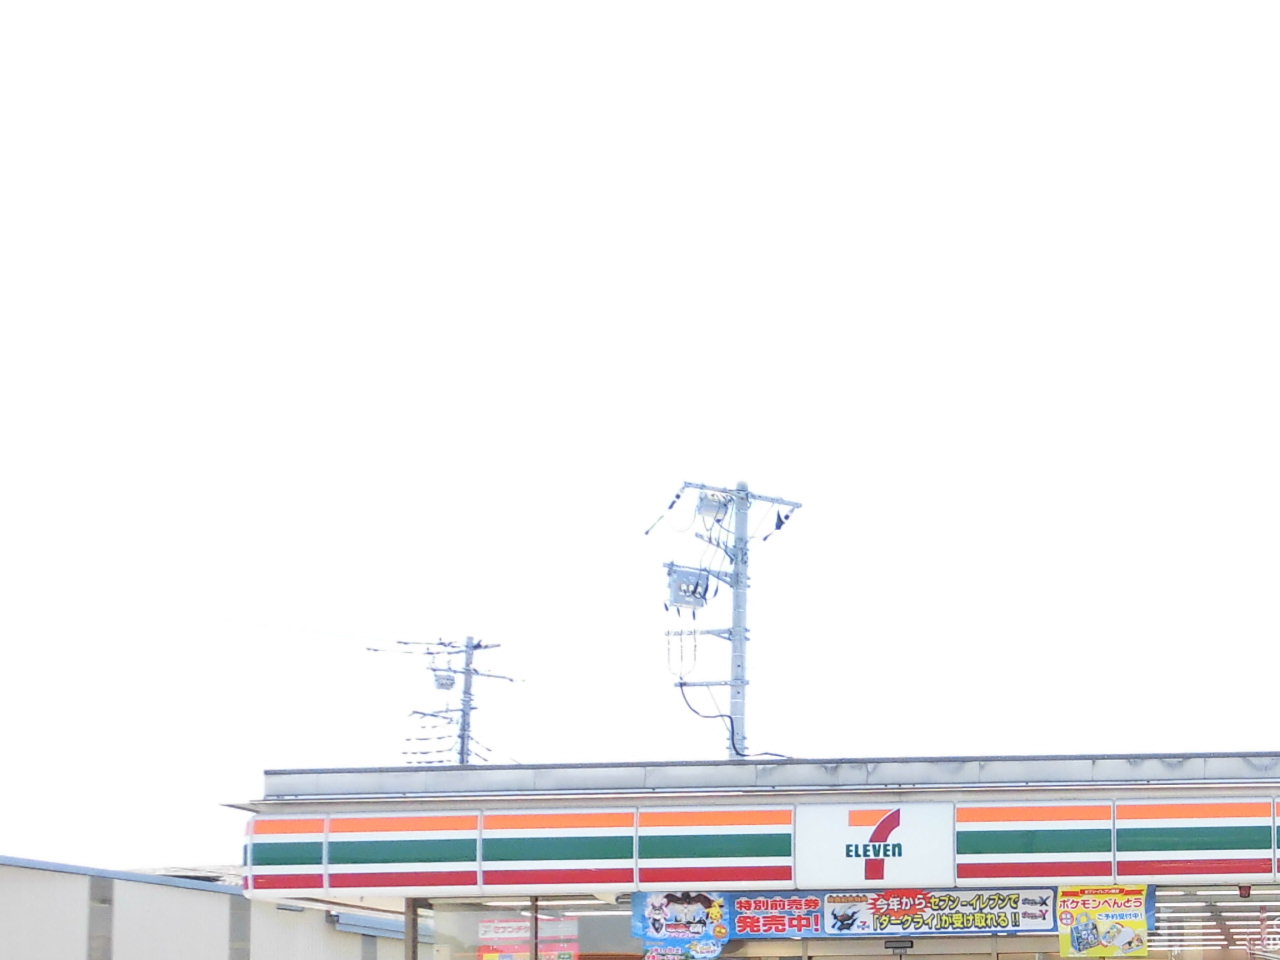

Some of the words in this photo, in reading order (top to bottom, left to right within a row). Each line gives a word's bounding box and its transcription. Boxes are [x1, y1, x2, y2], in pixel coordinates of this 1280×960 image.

[735, 898, 821, 911] 特別前売券
[876, 895, 926, 913] 今年から
[1060, 897, 1143, 909] ポケモンべんとう
